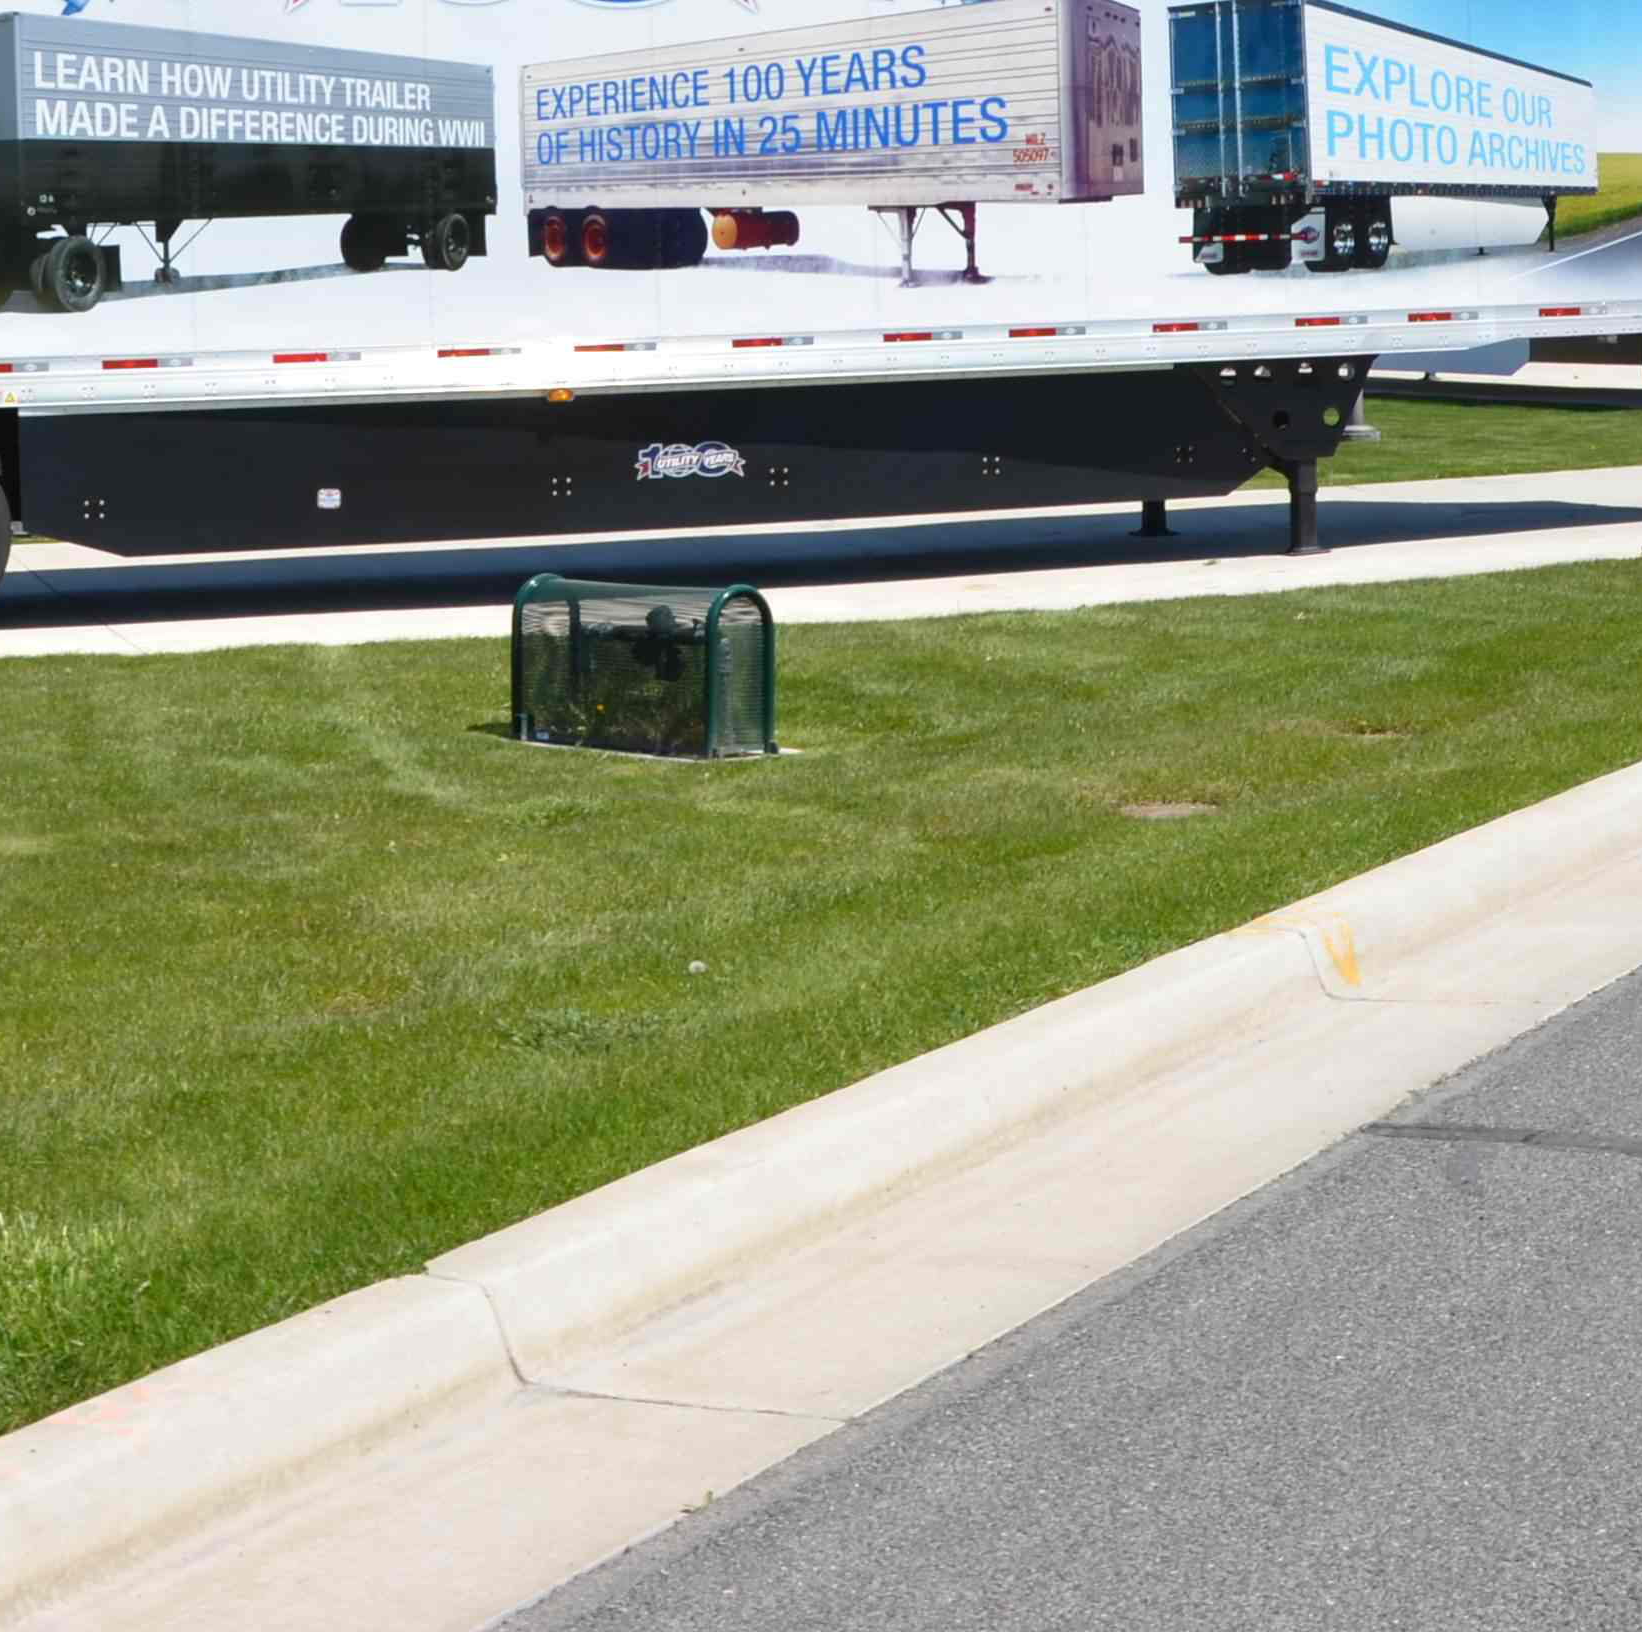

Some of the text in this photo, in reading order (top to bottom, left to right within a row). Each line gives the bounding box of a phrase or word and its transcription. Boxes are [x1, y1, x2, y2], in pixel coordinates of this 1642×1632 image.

[33, 50, 431, 112] LEARN HOW UTILITY TRAILER
[536, 44, 927, 121] EXPERIENCE 100 YEARS
[1325, 44, 1552, 128] EXPLORE OUR
[36, 98, 486, 148] MADE A DIFFERENCE DURING WWII
[537, 96, 1009, 166] OF HISTORY IN 25 MINUTES
[1326, 109, 1586, 176] PHOTO ARCHIVES
[657, 454, 699, 468] UTILITY
